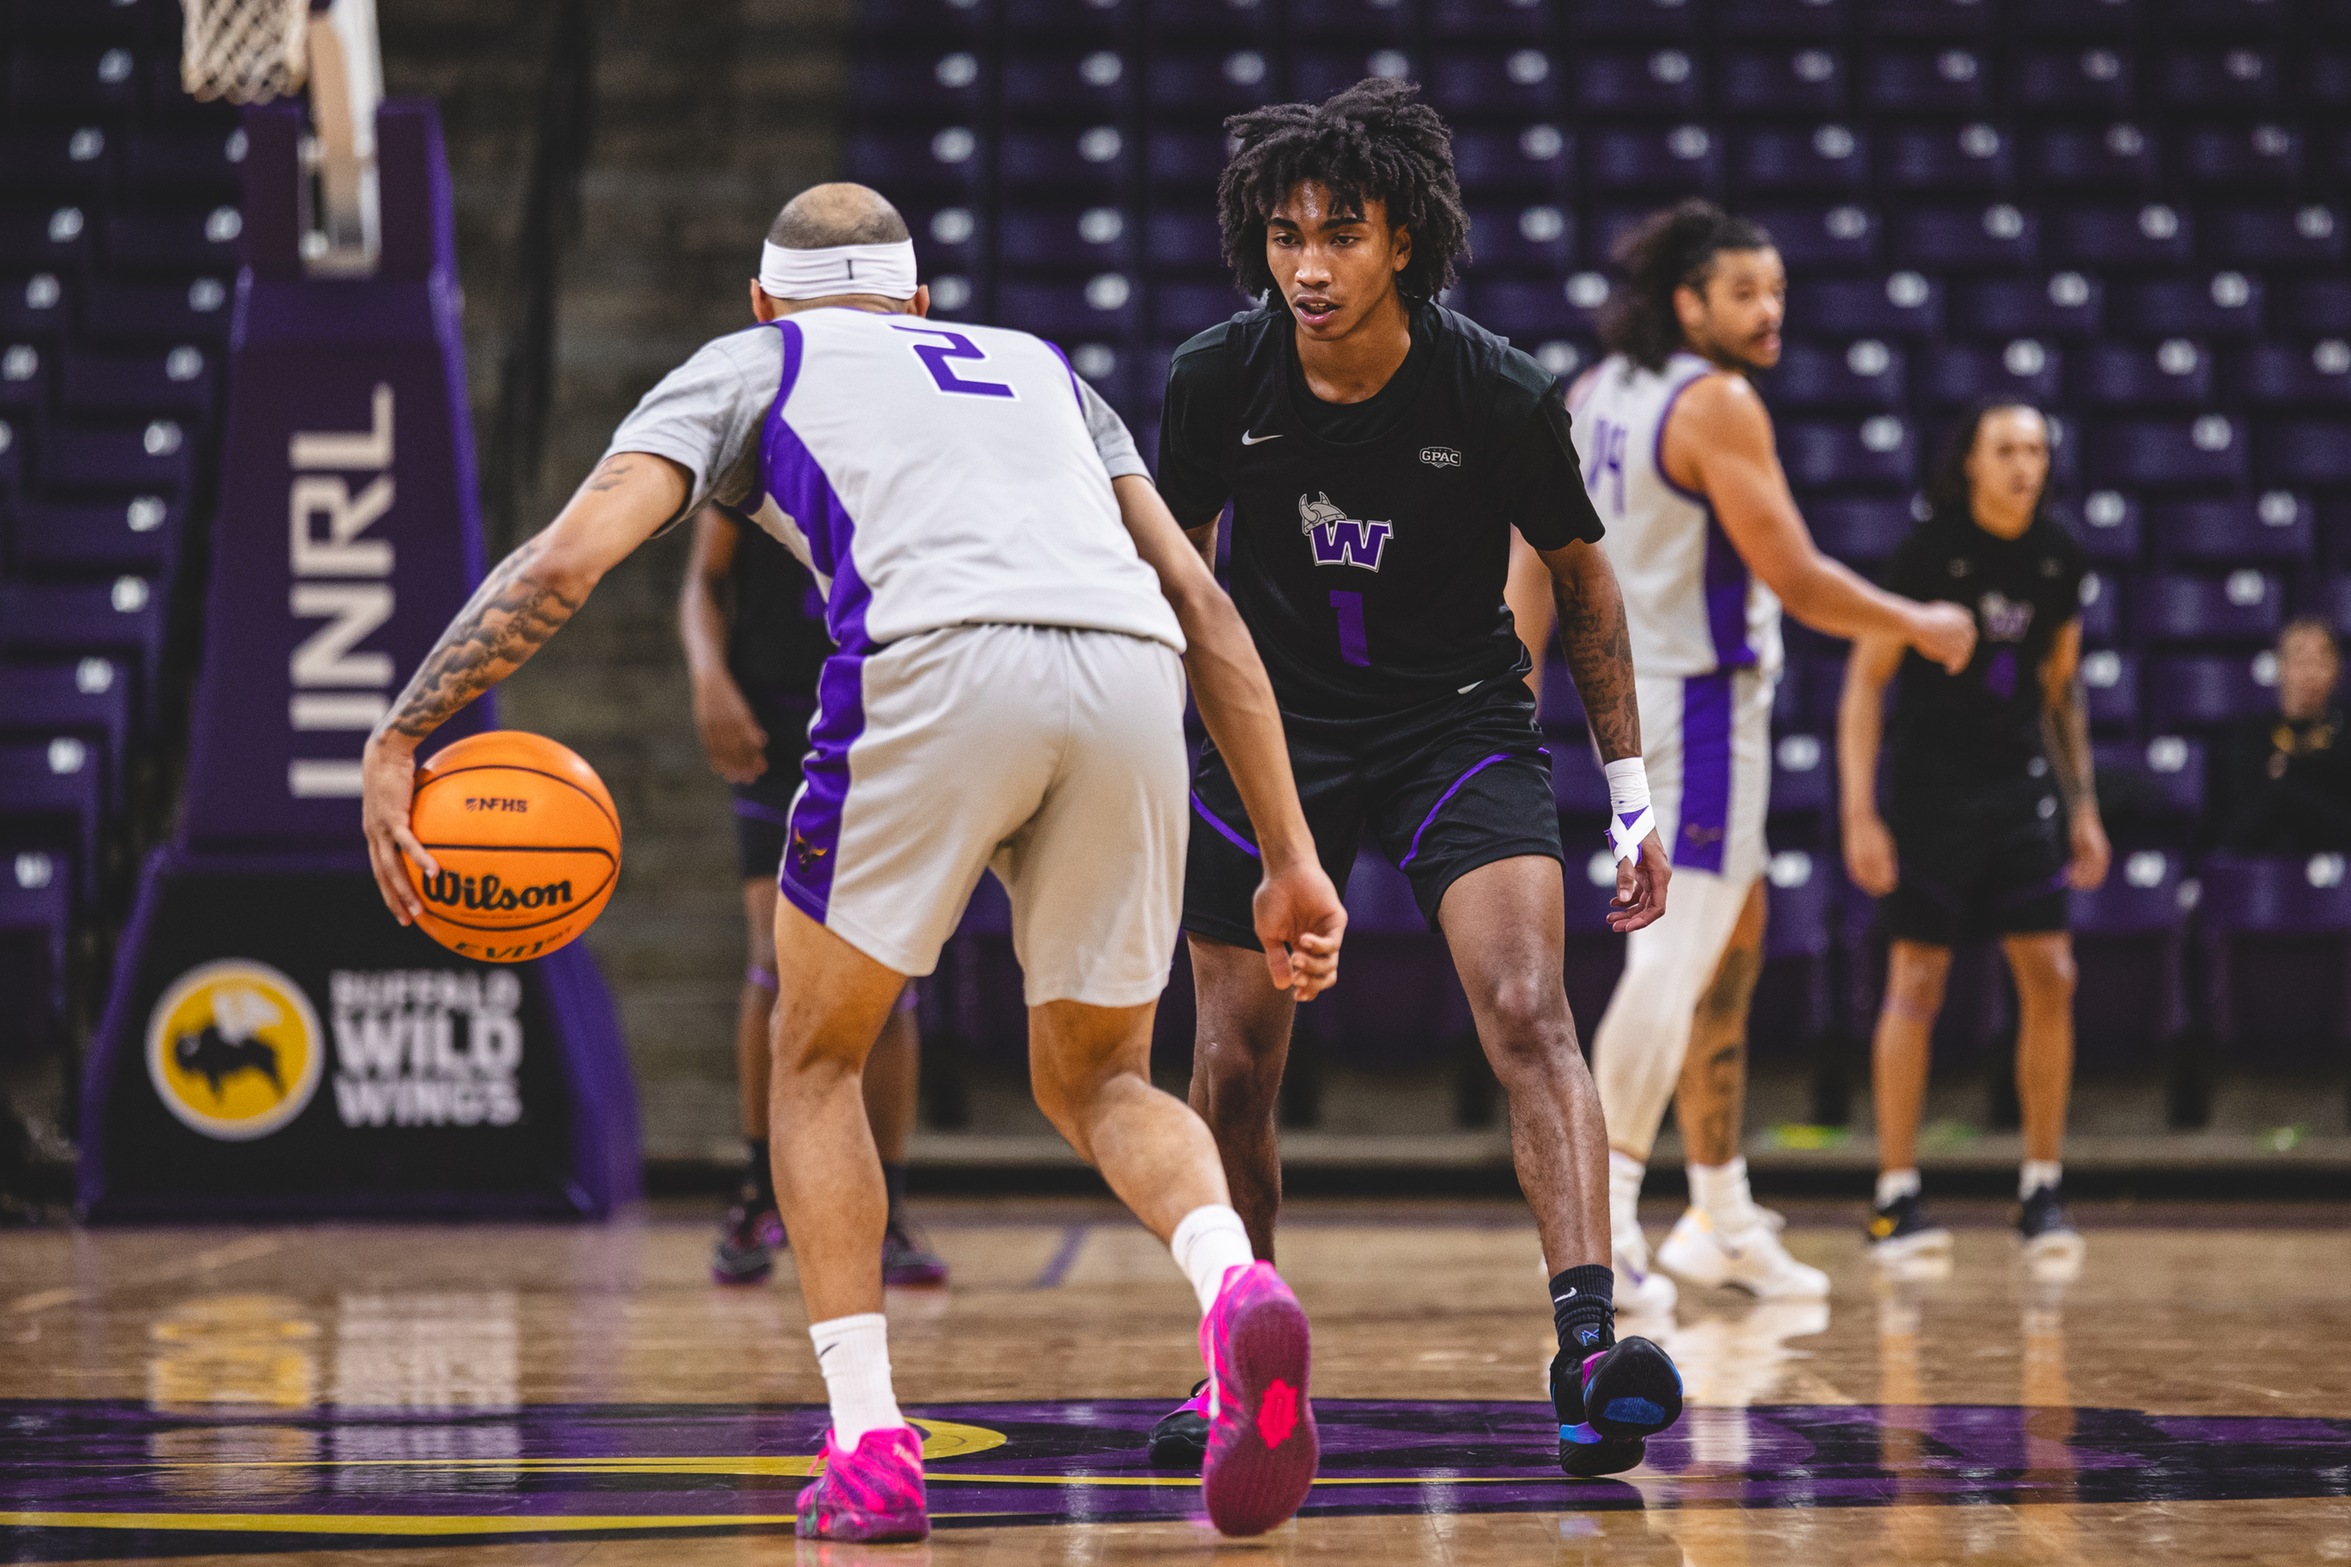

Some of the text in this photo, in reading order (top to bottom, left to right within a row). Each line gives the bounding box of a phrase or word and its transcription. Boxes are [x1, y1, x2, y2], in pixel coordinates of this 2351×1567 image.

[888, 322, 1018, 401] 2
[1421, 450, 1459, 465] GPAC
[1308, 519, 1394, 572] W
[1329, 589, 1370, 667] 1
[478, 798, 528, 813] NFHS
[422, 870, 573, 911] Wilson
[334, 1015, 523, 1073] WILD
[333, 1073, 523, 1127] WINGS
